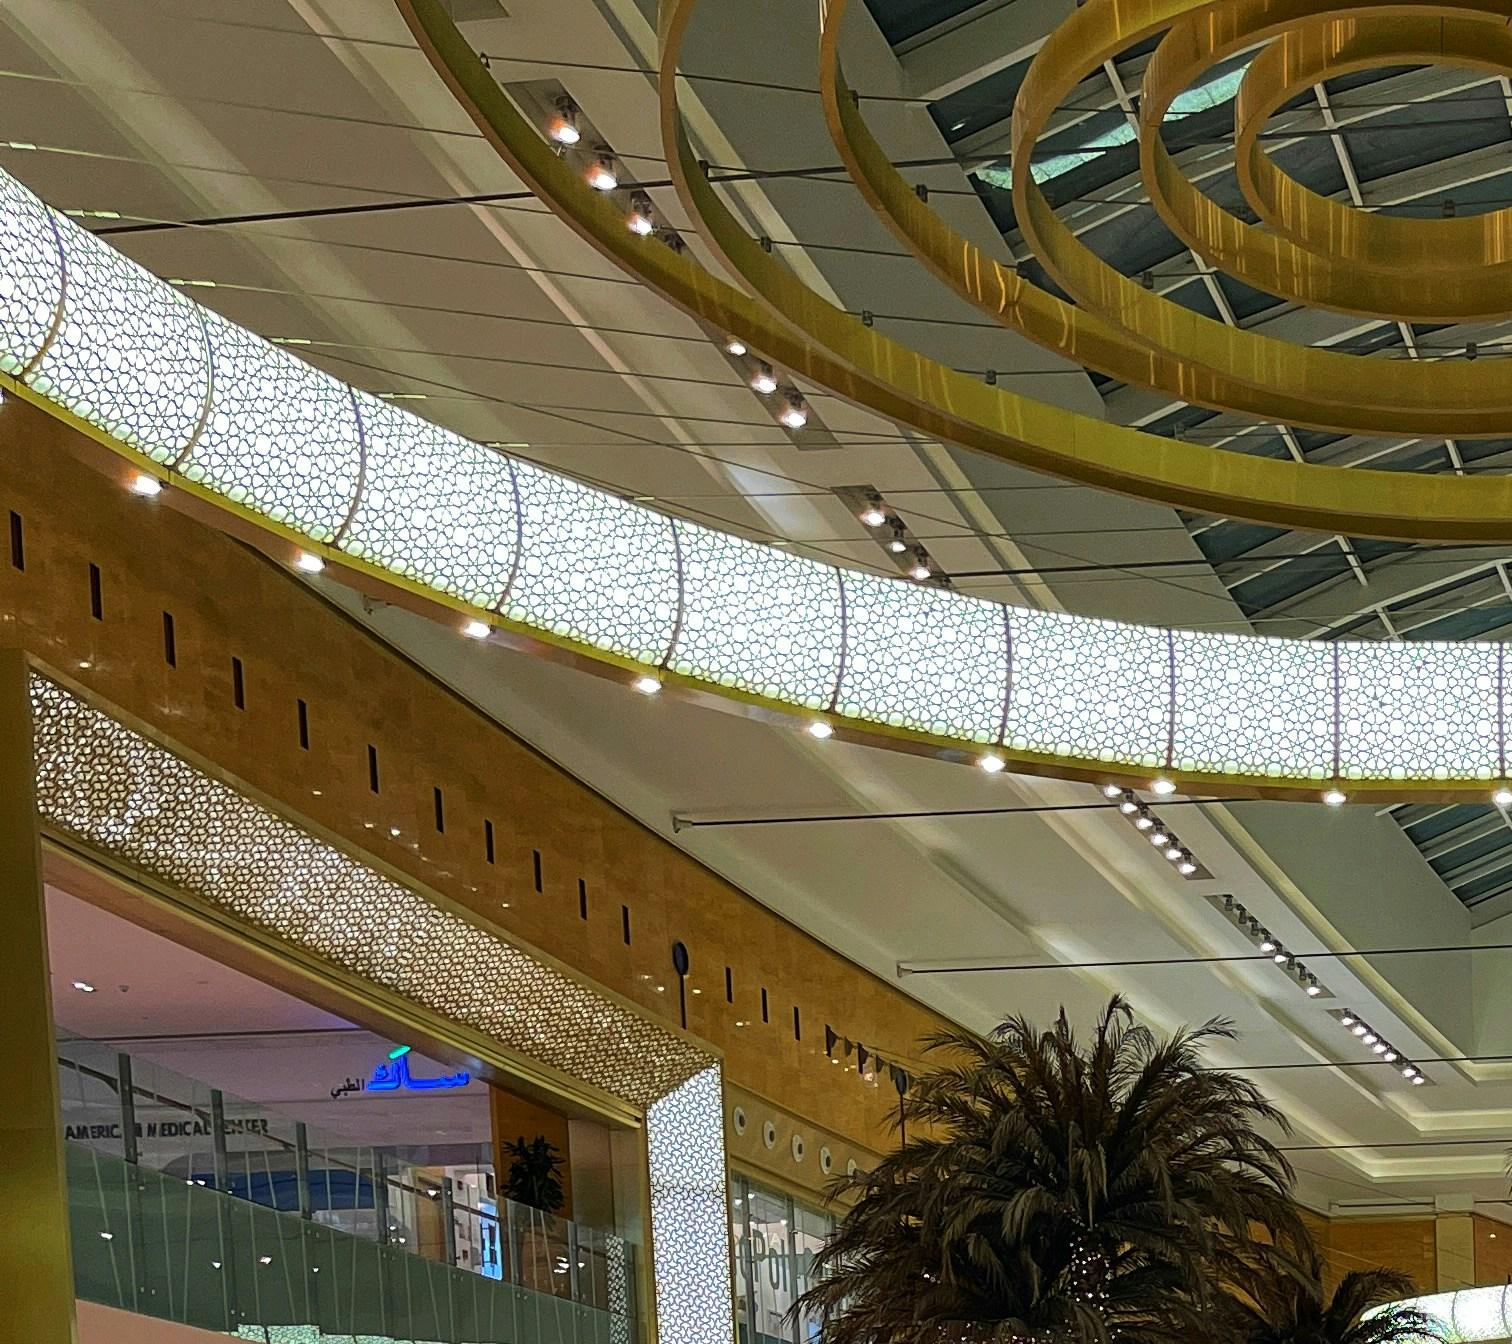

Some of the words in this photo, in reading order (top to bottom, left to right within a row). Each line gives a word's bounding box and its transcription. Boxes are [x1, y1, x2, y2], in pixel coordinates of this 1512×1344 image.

[65, 1123, 143, 1140] AMERICN
[147, 1120, 212, 1137] MEDICAL
[222, 1118, 269, 1135] ENTER
